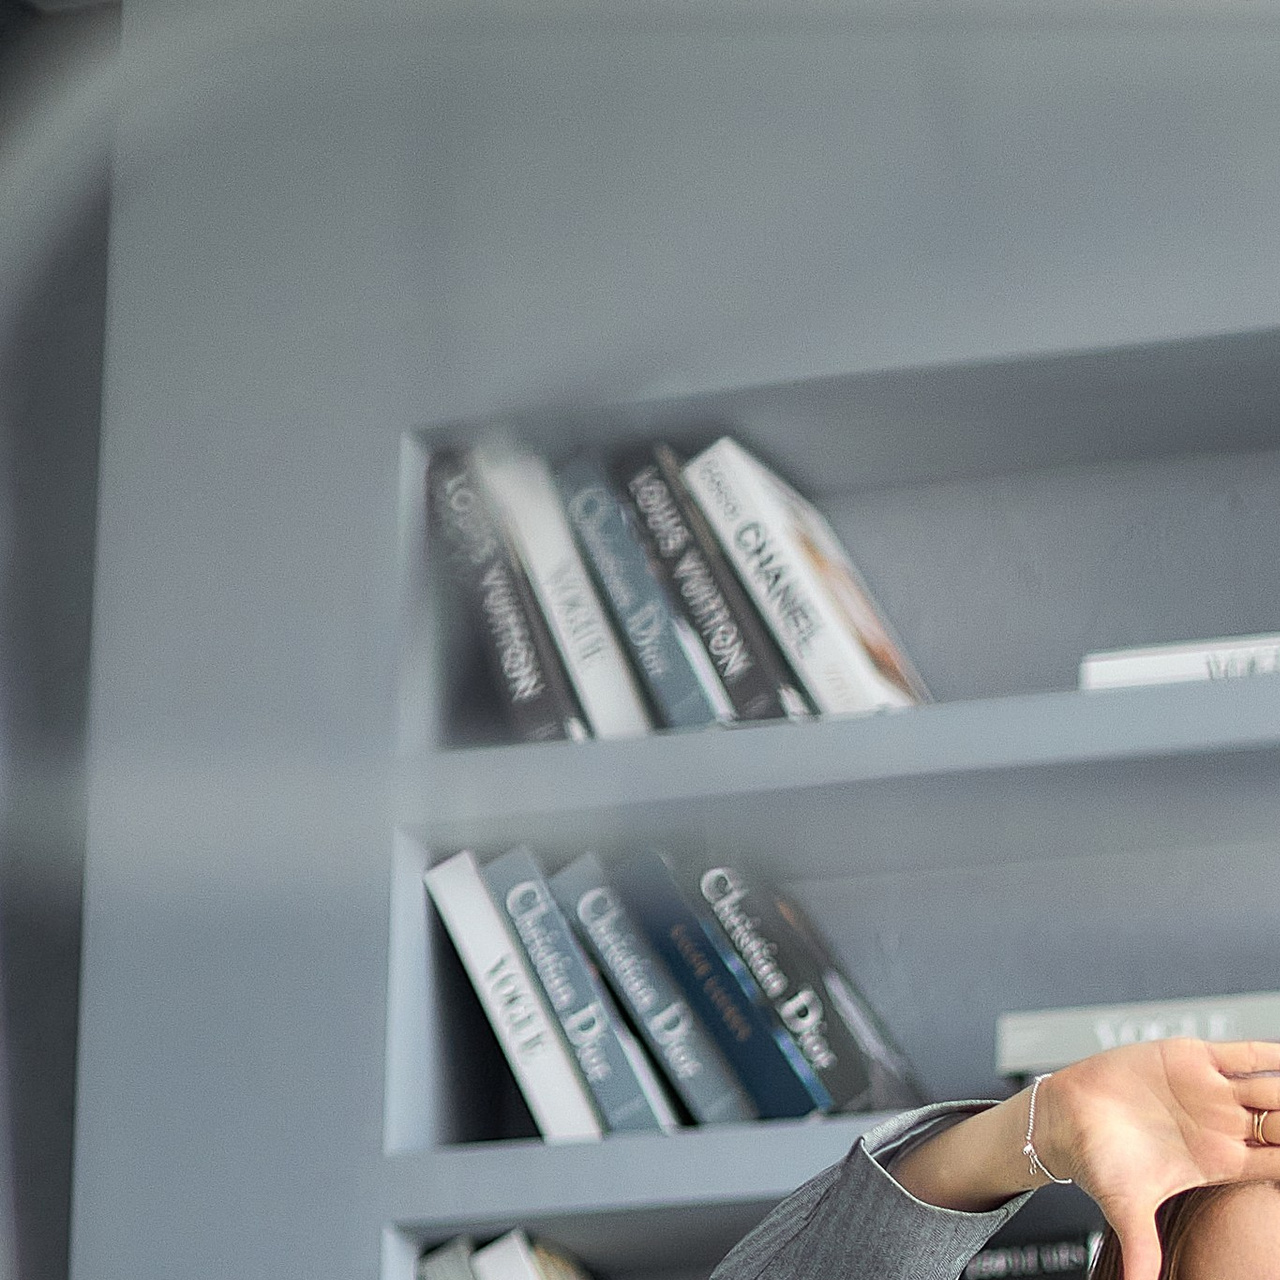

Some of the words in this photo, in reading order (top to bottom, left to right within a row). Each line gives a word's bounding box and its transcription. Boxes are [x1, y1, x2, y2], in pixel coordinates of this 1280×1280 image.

[481, 563, 545, 702] VUITTON
[627, 600, 668, 678] Dior
[628, 464, 691, 558] LOUIS
[673, 549, 752, 678] VUITTON
[734, 519, 821, 655] CHANEL
[483, 952, 545, 1058] VOGUE
[505, 879, 574, 1006] Christian
[563, 998, 612, 1083] Dior
[577, 884, 659, 1008] Christian
[646, 1000, 703, 1080] Dior
[700, 866, 789, 999] Christian
[779, 988, 839, 1070] Dior
